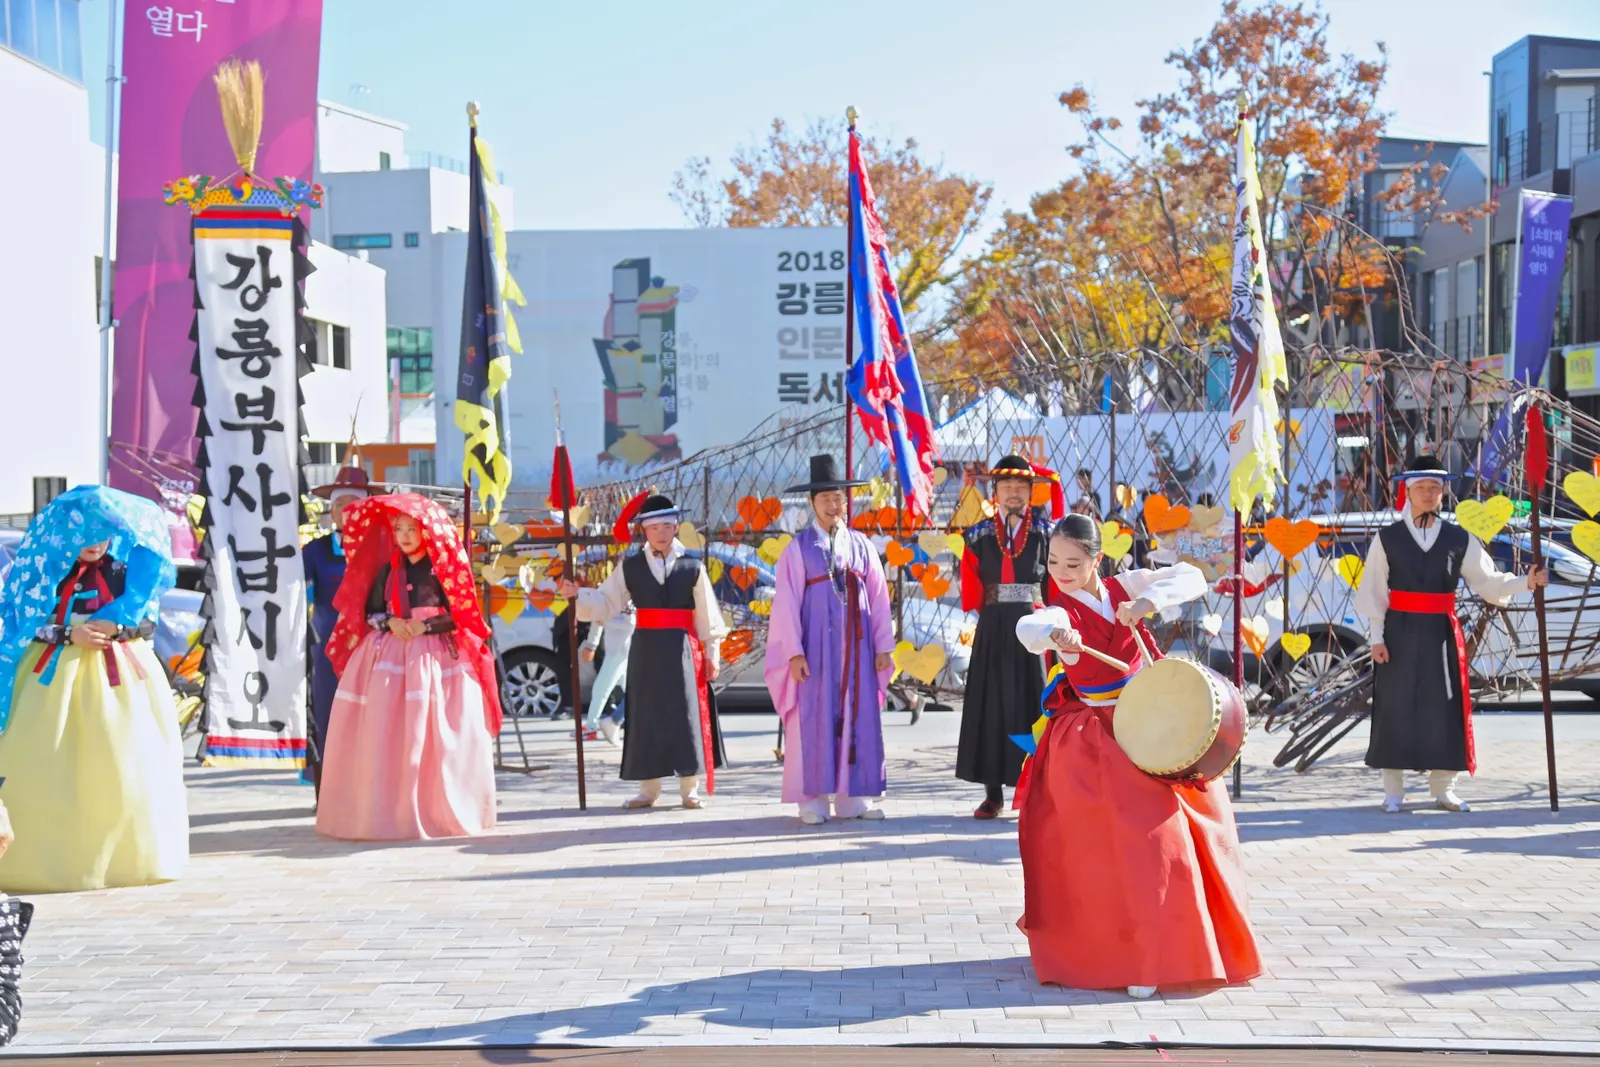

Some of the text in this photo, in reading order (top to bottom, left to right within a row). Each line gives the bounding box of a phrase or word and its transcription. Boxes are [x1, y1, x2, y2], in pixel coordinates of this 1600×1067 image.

[146, 5, 208, 42] 열다
[776, 250, 845, 272] 2018
[776, 281, 845, 316] 강릉
[776, 326, 845, 360] 인문
[777, 372, 844, 405] 독서
